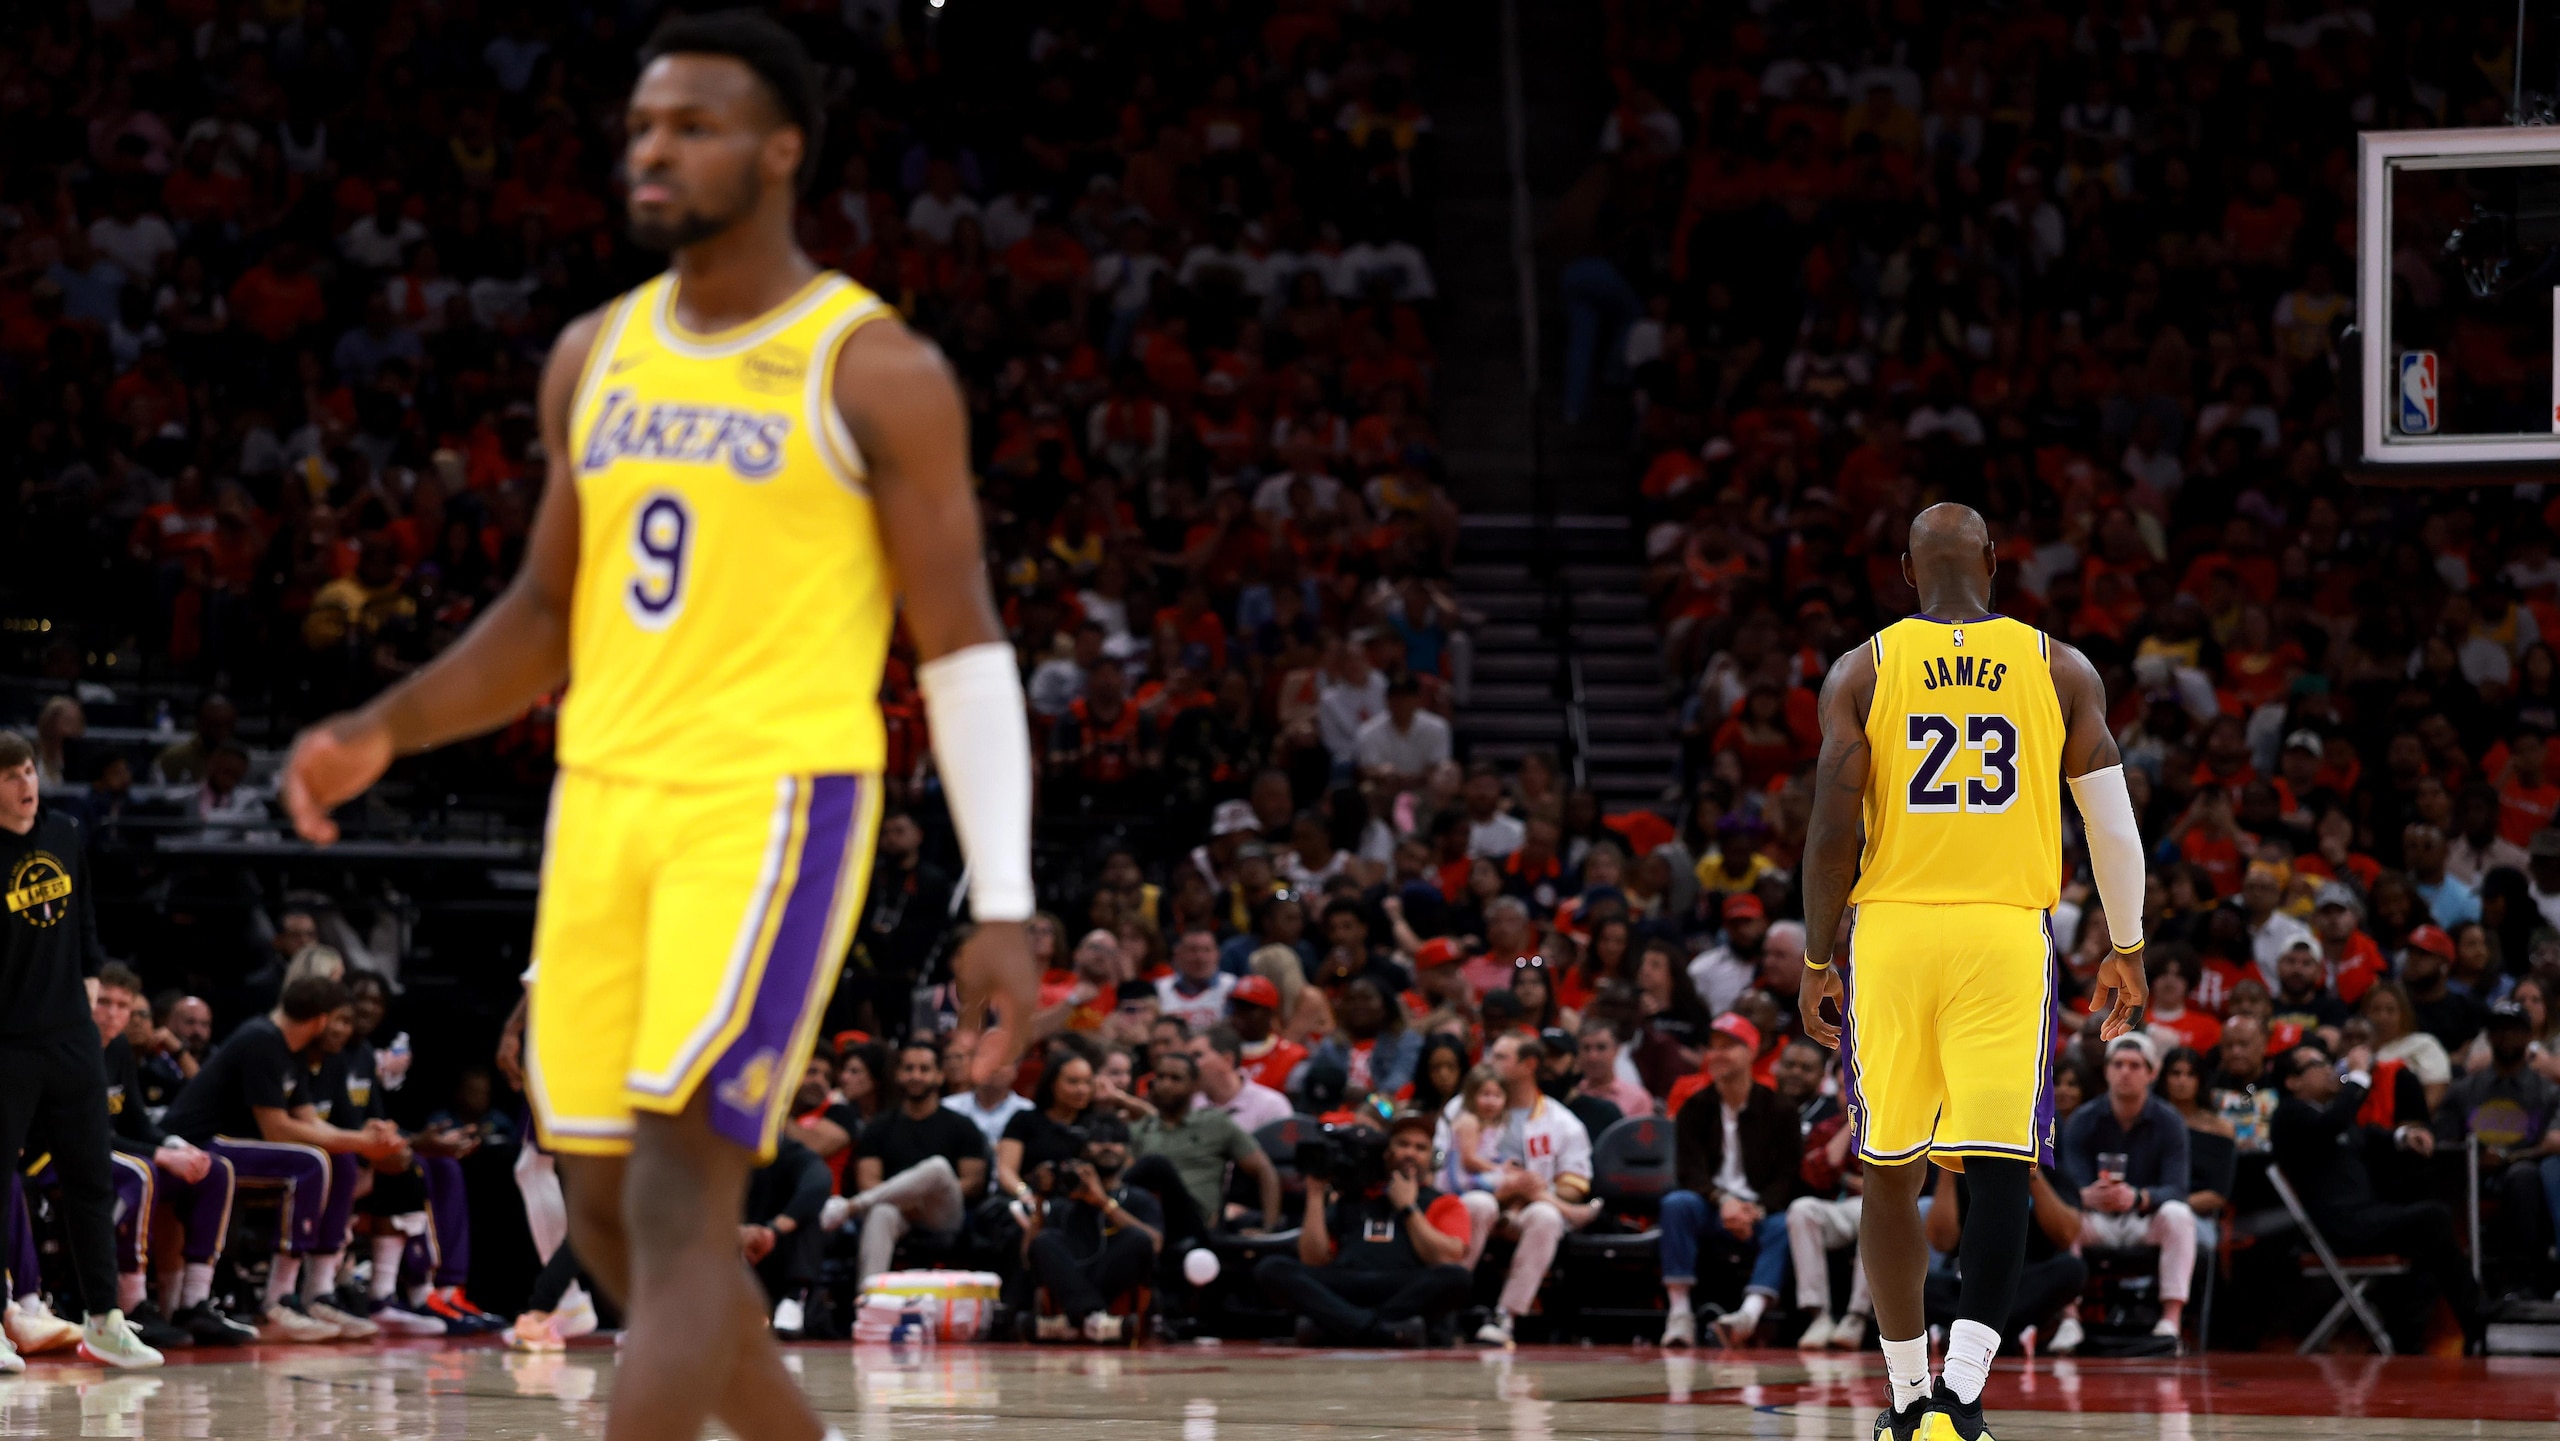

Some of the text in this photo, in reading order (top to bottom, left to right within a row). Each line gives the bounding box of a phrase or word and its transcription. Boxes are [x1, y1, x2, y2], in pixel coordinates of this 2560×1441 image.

[583, 391, 791, 478] LAKERS
[627, 491, 691, 625] 9
[1923, 656, 2007, 692] JAMES
[1906, 713, 2019, 814] 23
